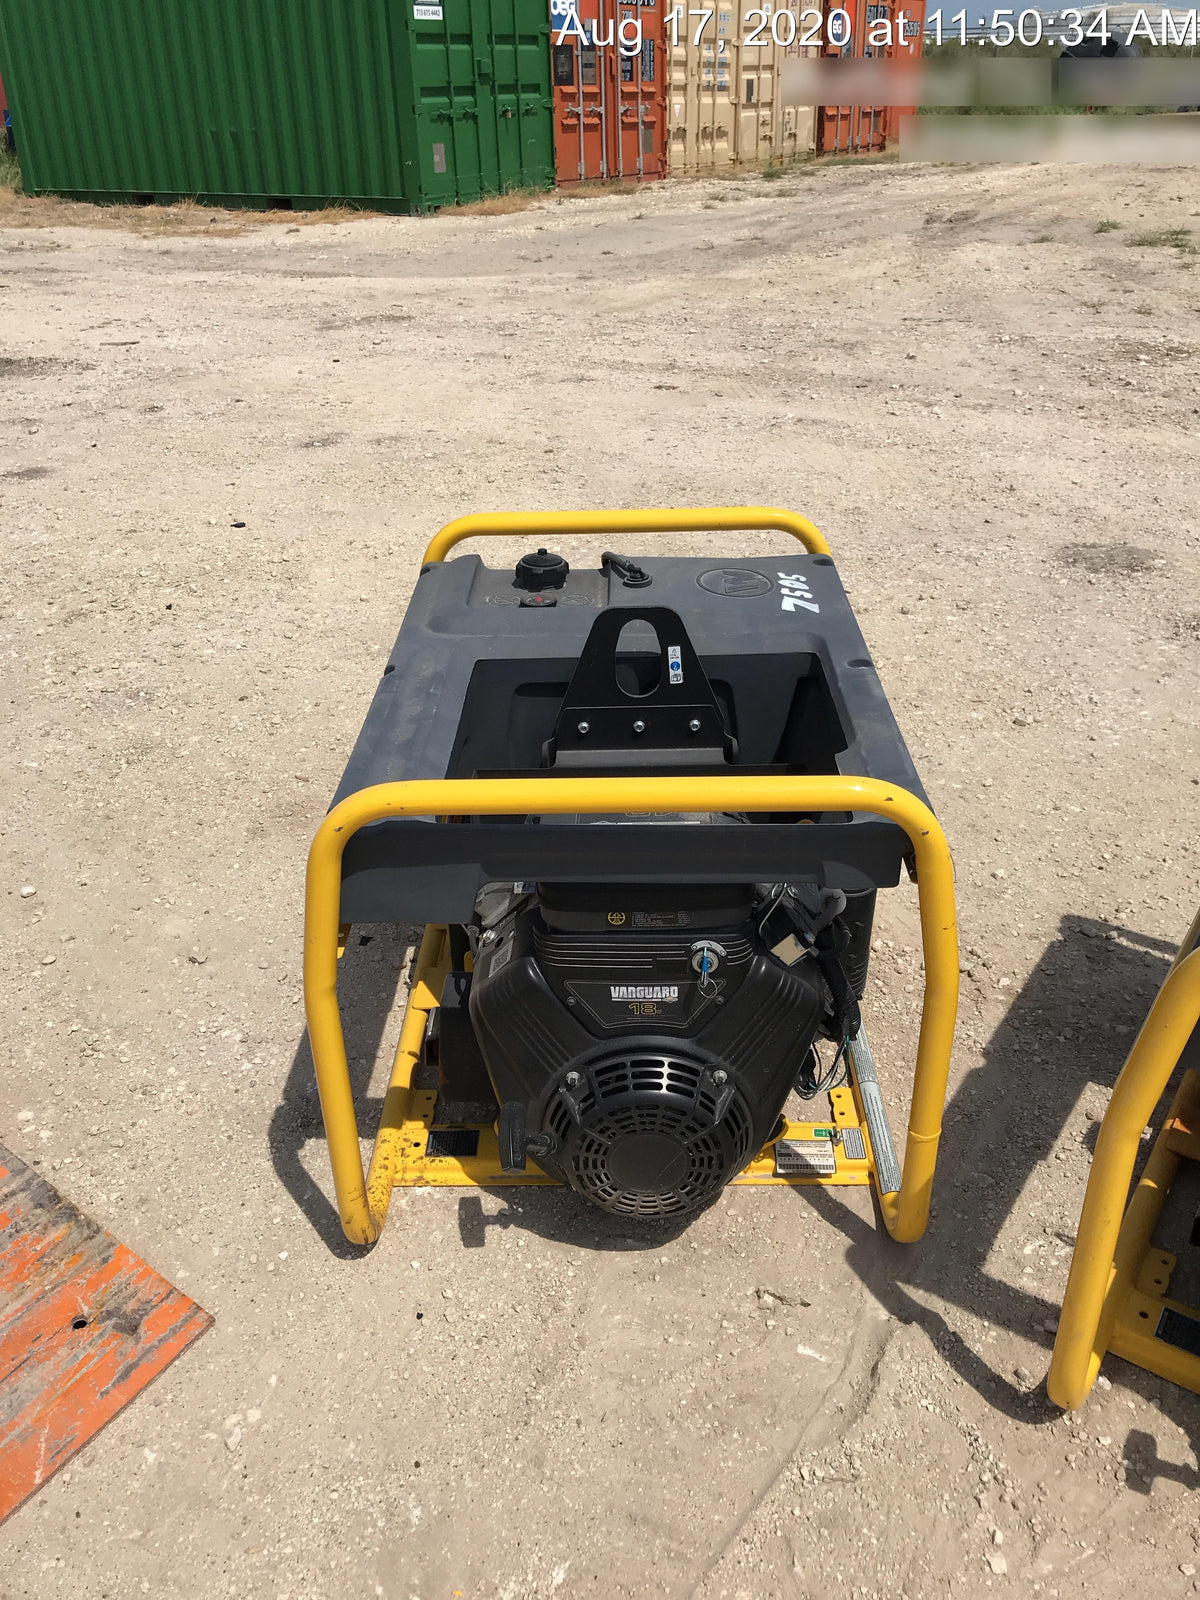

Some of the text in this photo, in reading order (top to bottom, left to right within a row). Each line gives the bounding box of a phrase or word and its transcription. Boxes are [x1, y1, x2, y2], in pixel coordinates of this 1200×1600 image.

[777, 572, 820, 614] 7505
[610, 986, 679, 999] VANGUARD
[628, 1002, 657, 1015] 18
